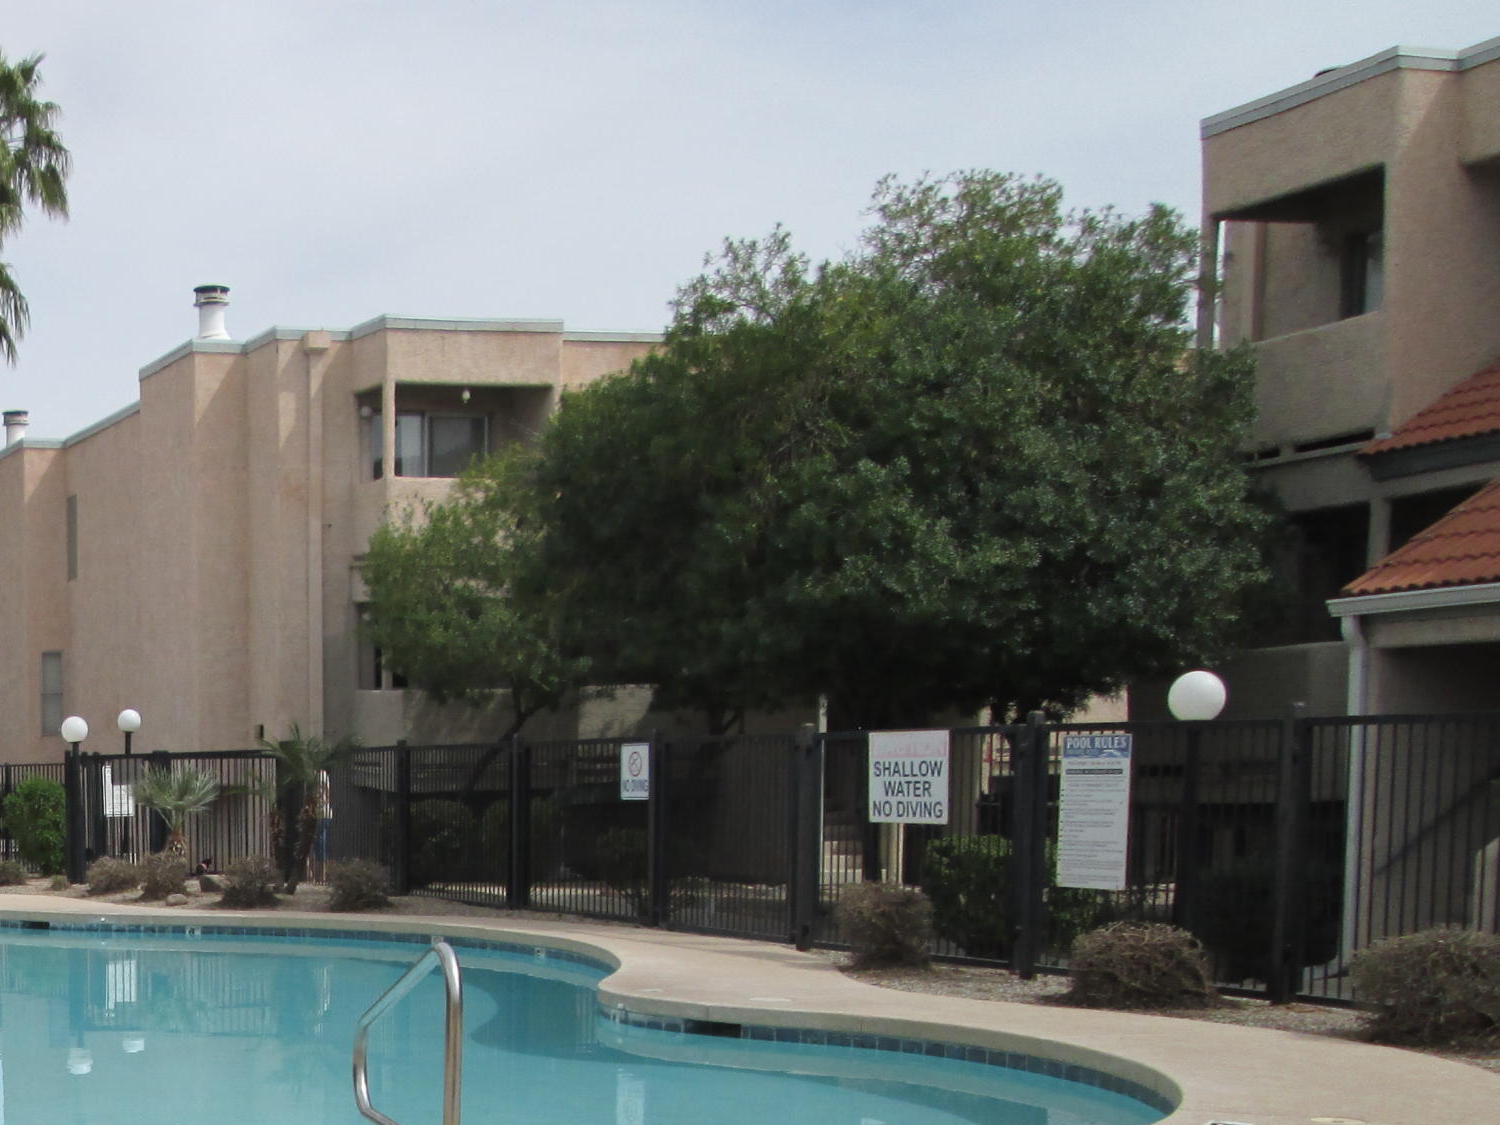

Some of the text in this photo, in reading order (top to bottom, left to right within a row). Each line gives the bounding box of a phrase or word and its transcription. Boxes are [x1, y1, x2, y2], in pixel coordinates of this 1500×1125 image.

[1067, 735, 1127, 749] POOL RULES
[874, 760, 943, 777] SHALLOW
[884, 781, 932, 797] WATER
[873, 801, 944, 818] NO DIVING
